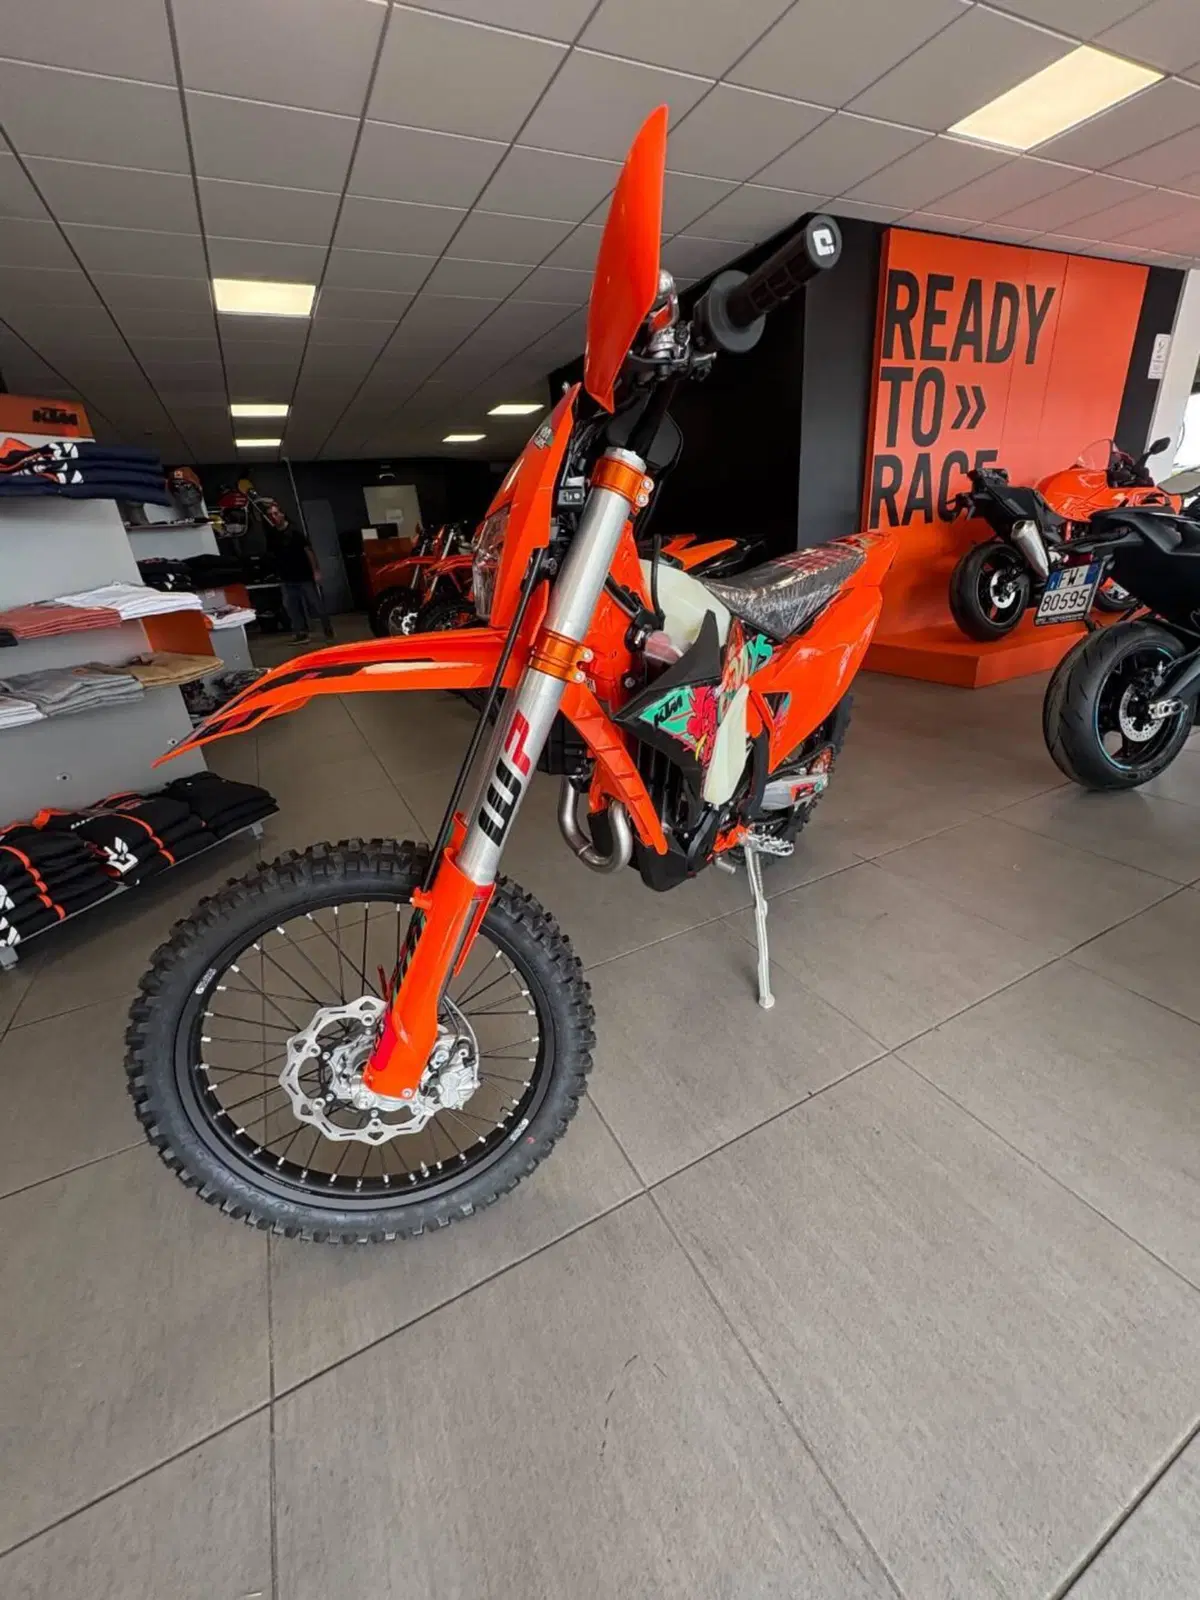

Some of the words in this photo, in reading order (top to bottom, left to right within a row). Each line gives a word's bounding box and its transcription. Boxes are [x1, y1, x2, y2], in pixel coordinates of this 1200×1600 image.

[883, 269, 1056, 365] READY
[32, 406, 77, 425] KTM
[880, 366, 945, 448] TO
[869, 449, 998, 529] RAC
[1041, 589, 1089, 612] 80595
[653, 694, 683, 729] KTM
